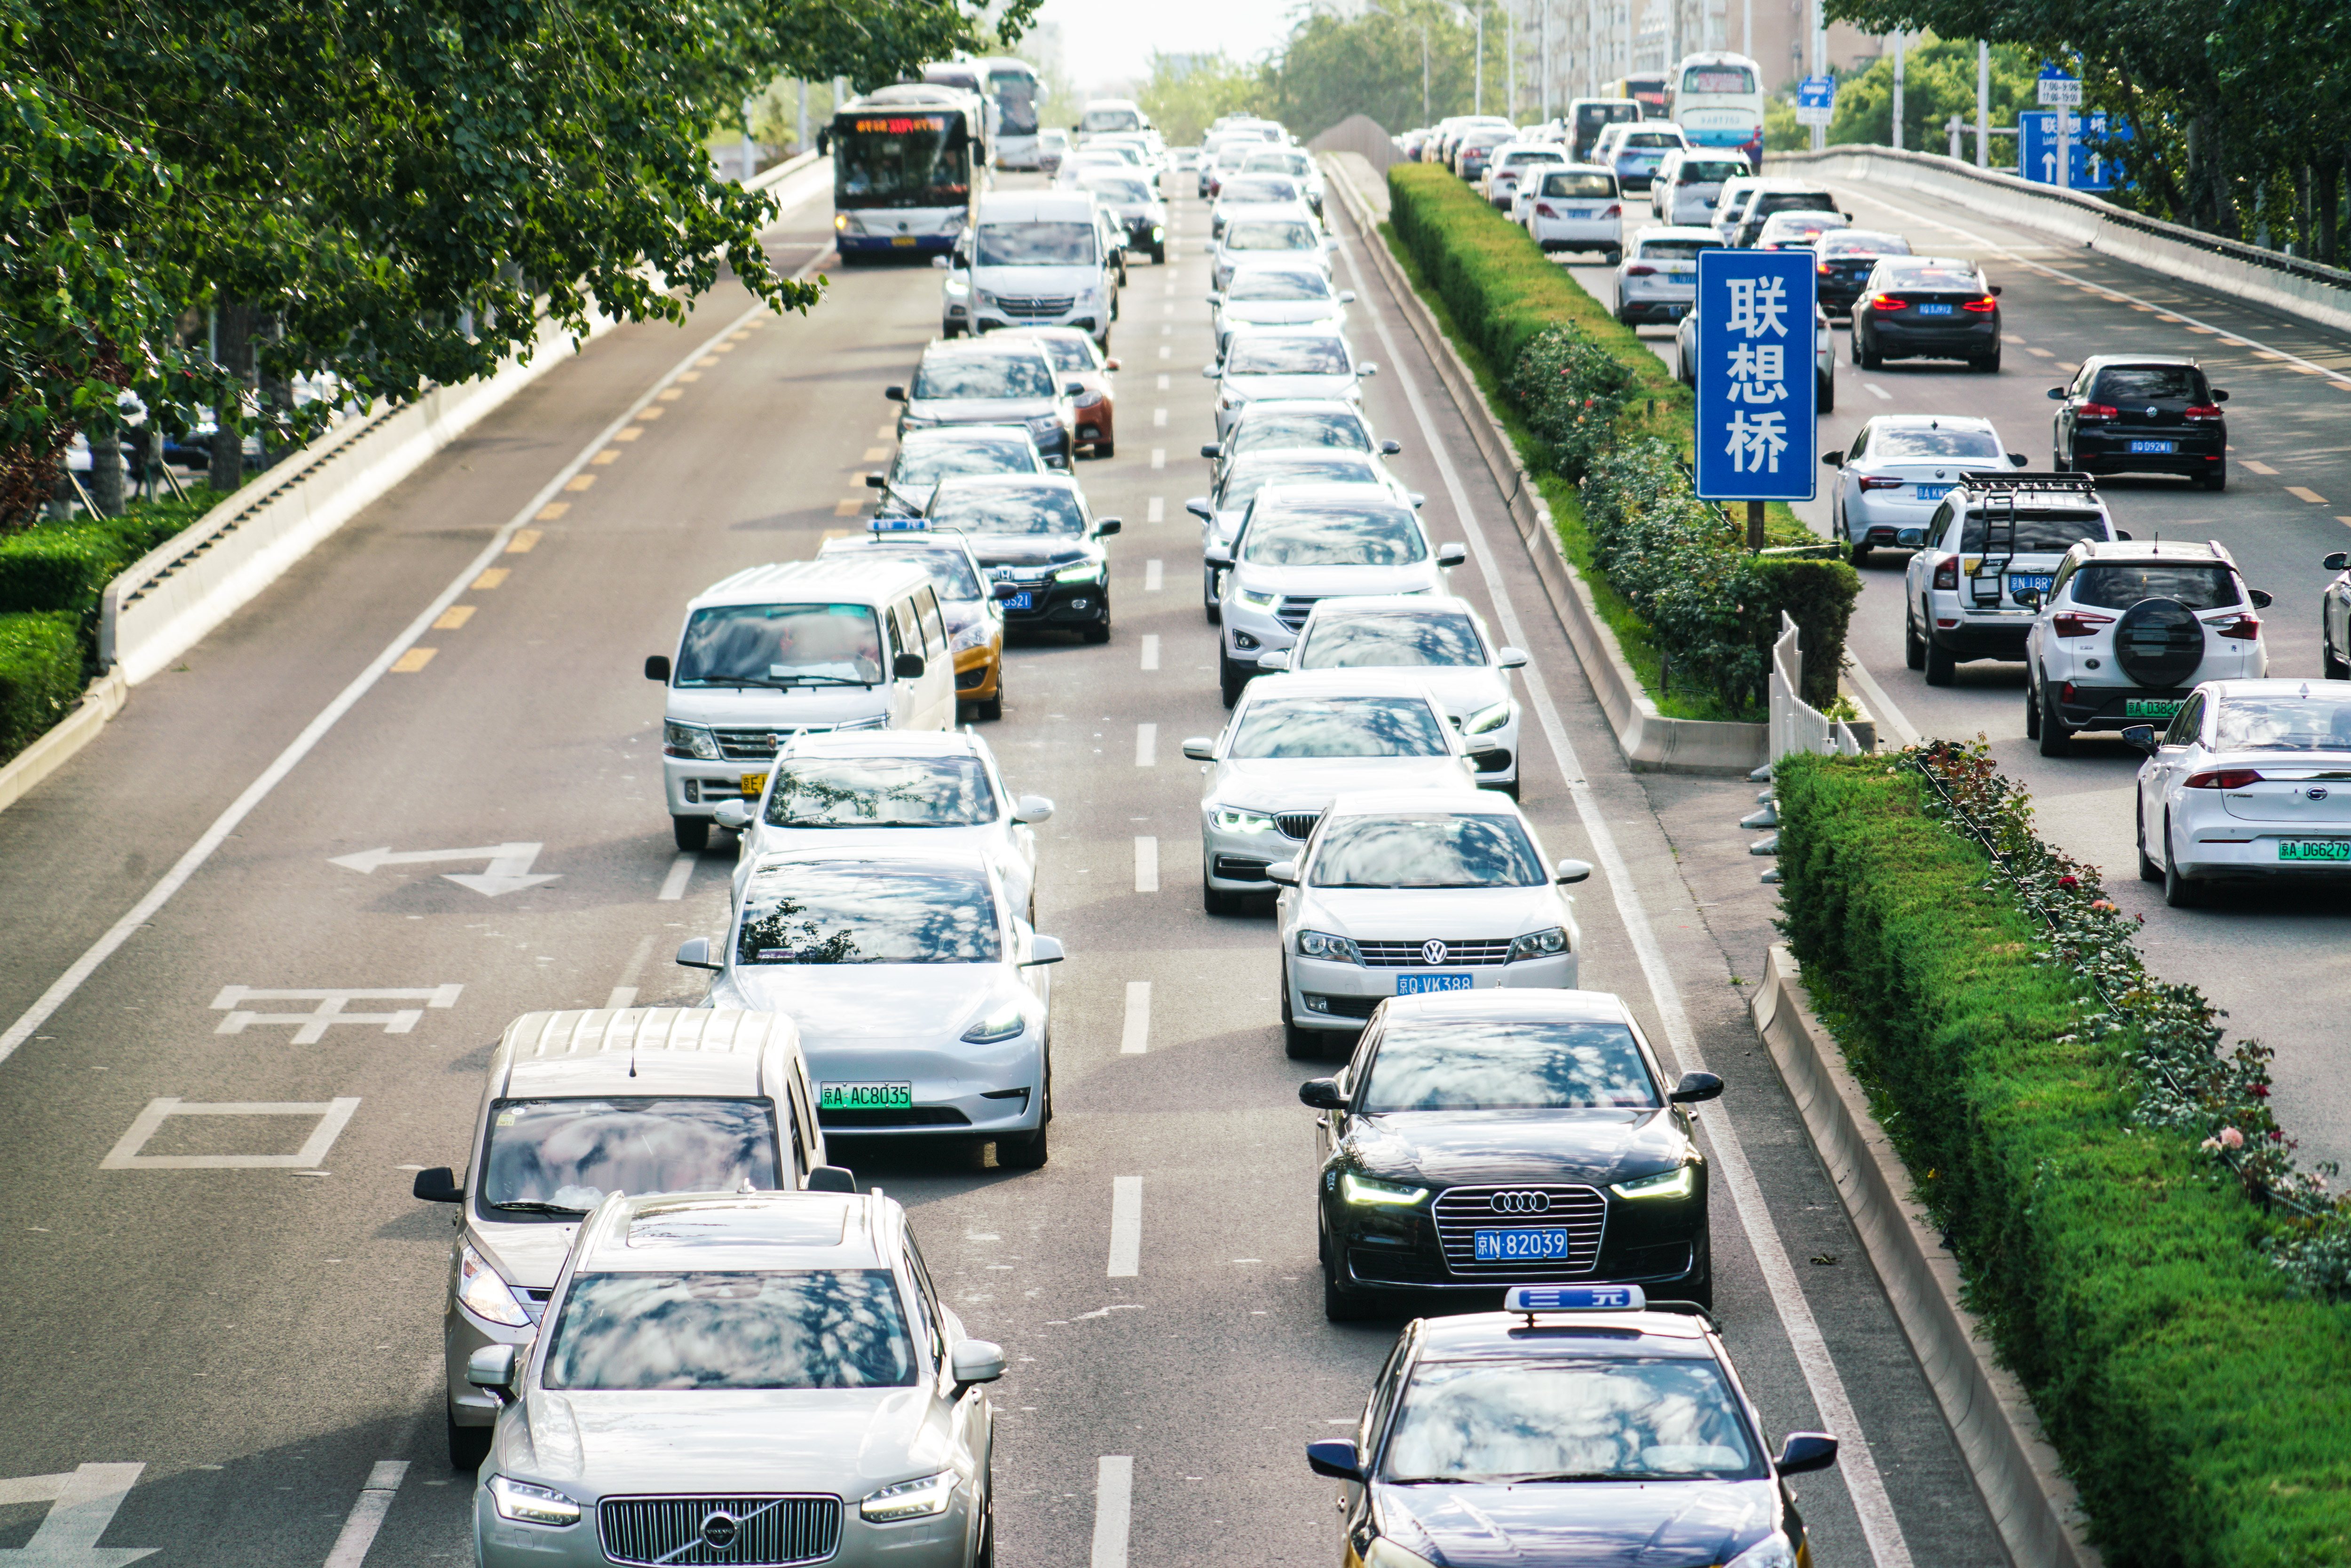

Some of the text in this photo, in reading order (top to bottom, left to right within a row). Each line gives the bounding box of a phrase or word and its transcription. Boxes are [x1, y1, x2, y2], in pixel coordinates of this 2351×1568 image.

[1725, 276, 1789, 473] 联想桥
[1478, 1233, 1565, 1255] 京N·82039
[1529, 1289, 1623, 1306] 三元
